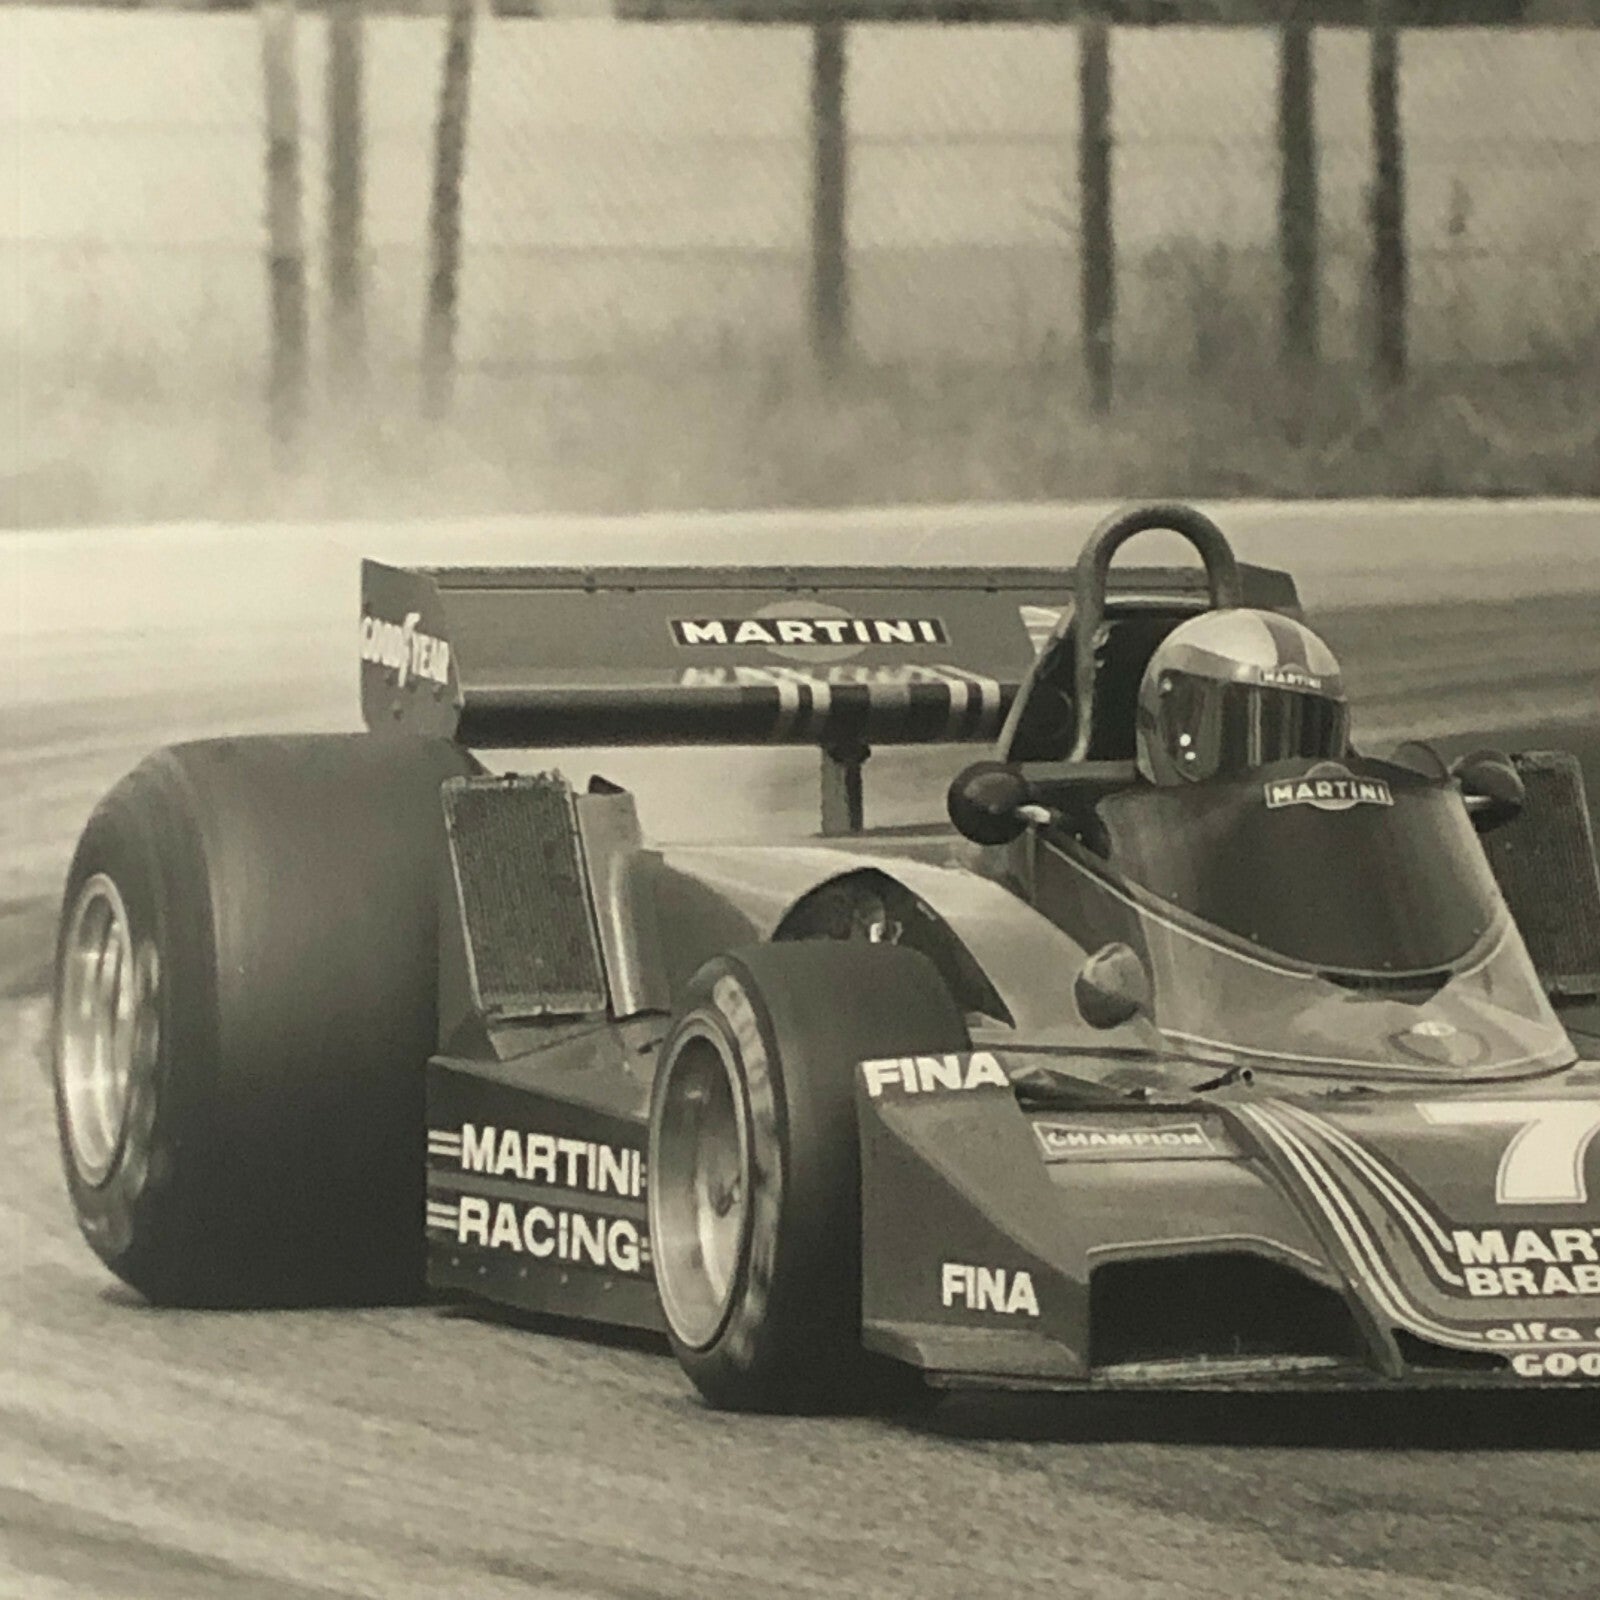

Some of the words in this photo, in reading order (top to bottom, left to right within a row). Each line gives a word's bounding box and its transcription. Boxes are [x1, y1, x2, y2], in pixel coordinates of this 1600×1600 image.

[681, 619, 938, 645] MARTINI
[1263, 671, 1322, 690] MARTINI
[1271, 780, 1389, 804] MARTINI
[861, 1051, 1011, 1098] FINA
[1043, 1129, 1205, 1149] CHAMPION
[1414, 1099, 1600, 1205] 7
[461, 1122, 640, 1197] MARTINI
[457, 1195, 641, 1273] RACING
[1451, 1227, 1600, 1265] MAR
[941, 1262, 1041, 1317] FINA
[1463, 1264, 1600, 1297] BRAB
